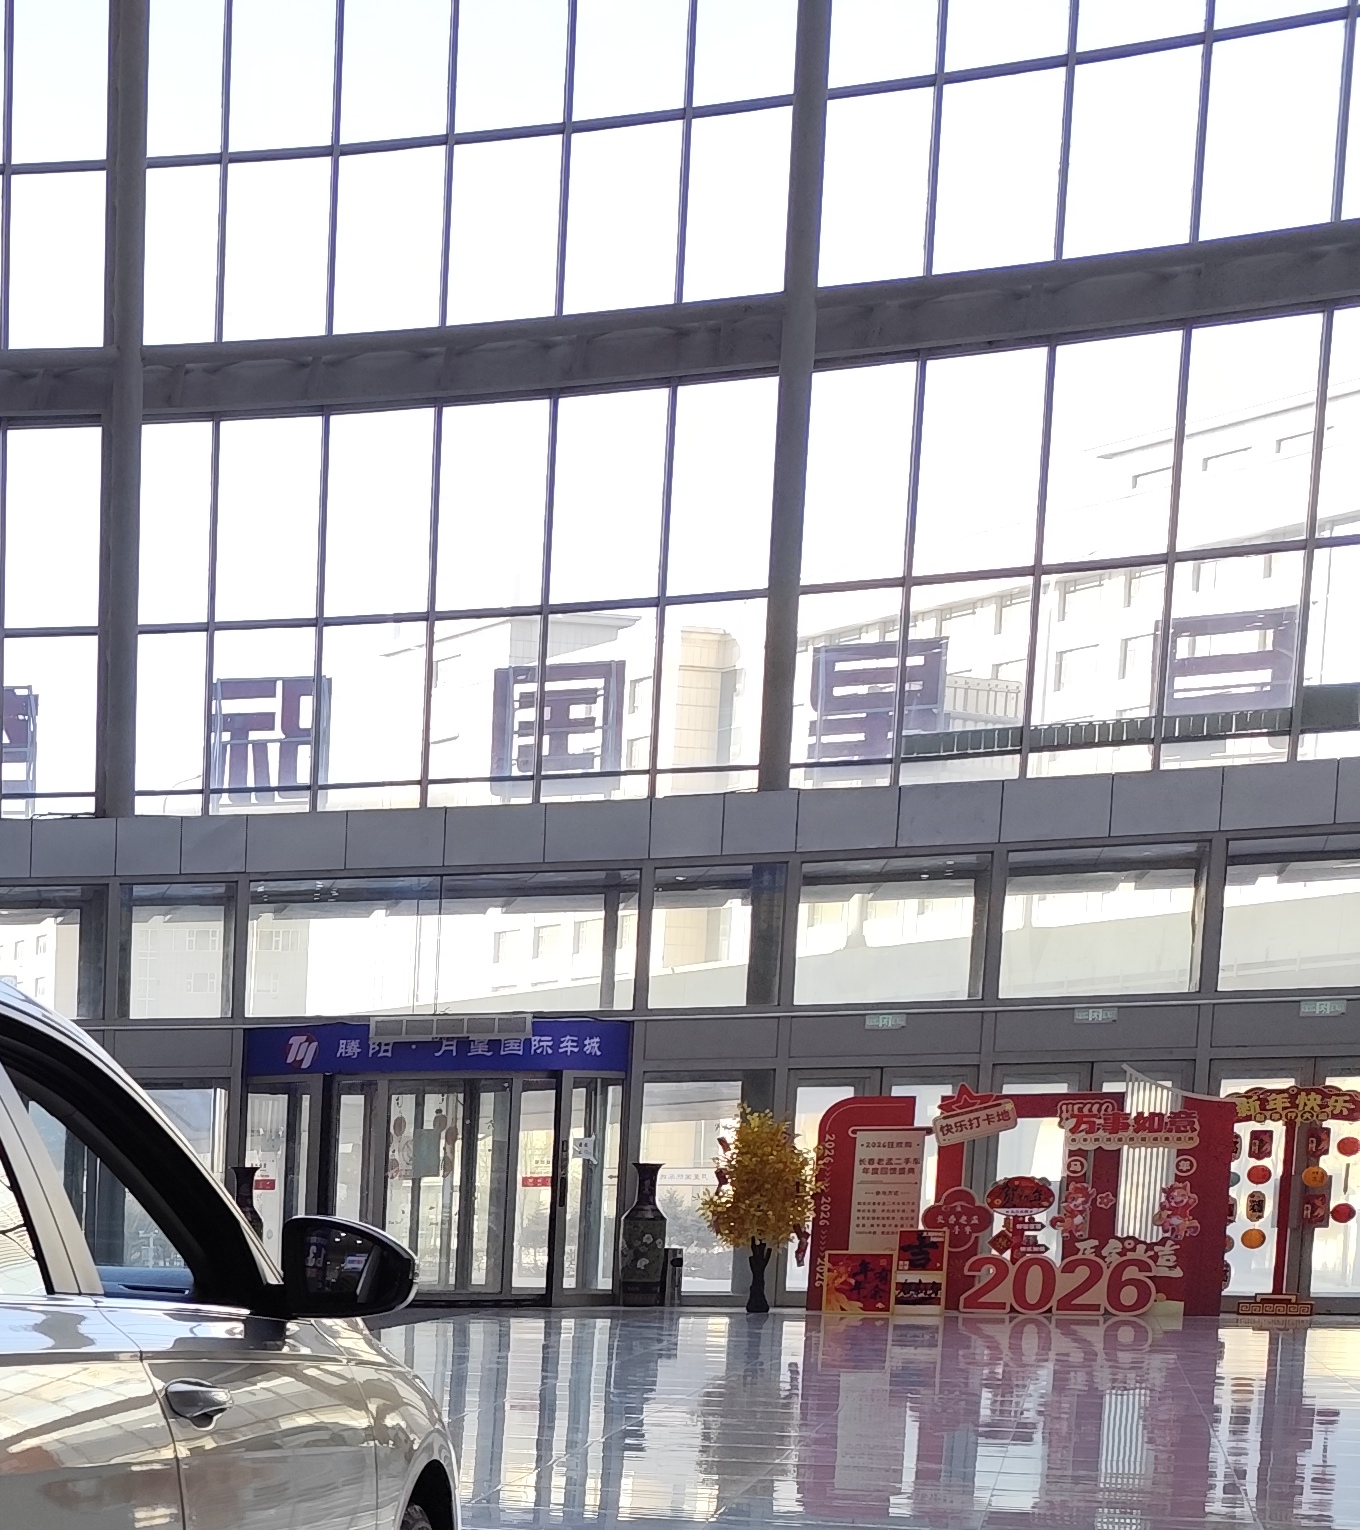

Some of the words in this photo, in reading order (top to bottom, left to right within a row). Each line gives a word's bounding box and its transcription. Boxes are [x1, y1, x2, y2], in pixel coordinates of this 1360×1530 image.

[1235, 1092, 1356, 1117] 新年快乐
[940, 1109, 1011, 1136] 快乐打卡地
[1068, 1110, 1198, 1135] 万事如意
[818, 1196, 831, 1226] 2026
[962, 1256, 1154, 1313] 2026
